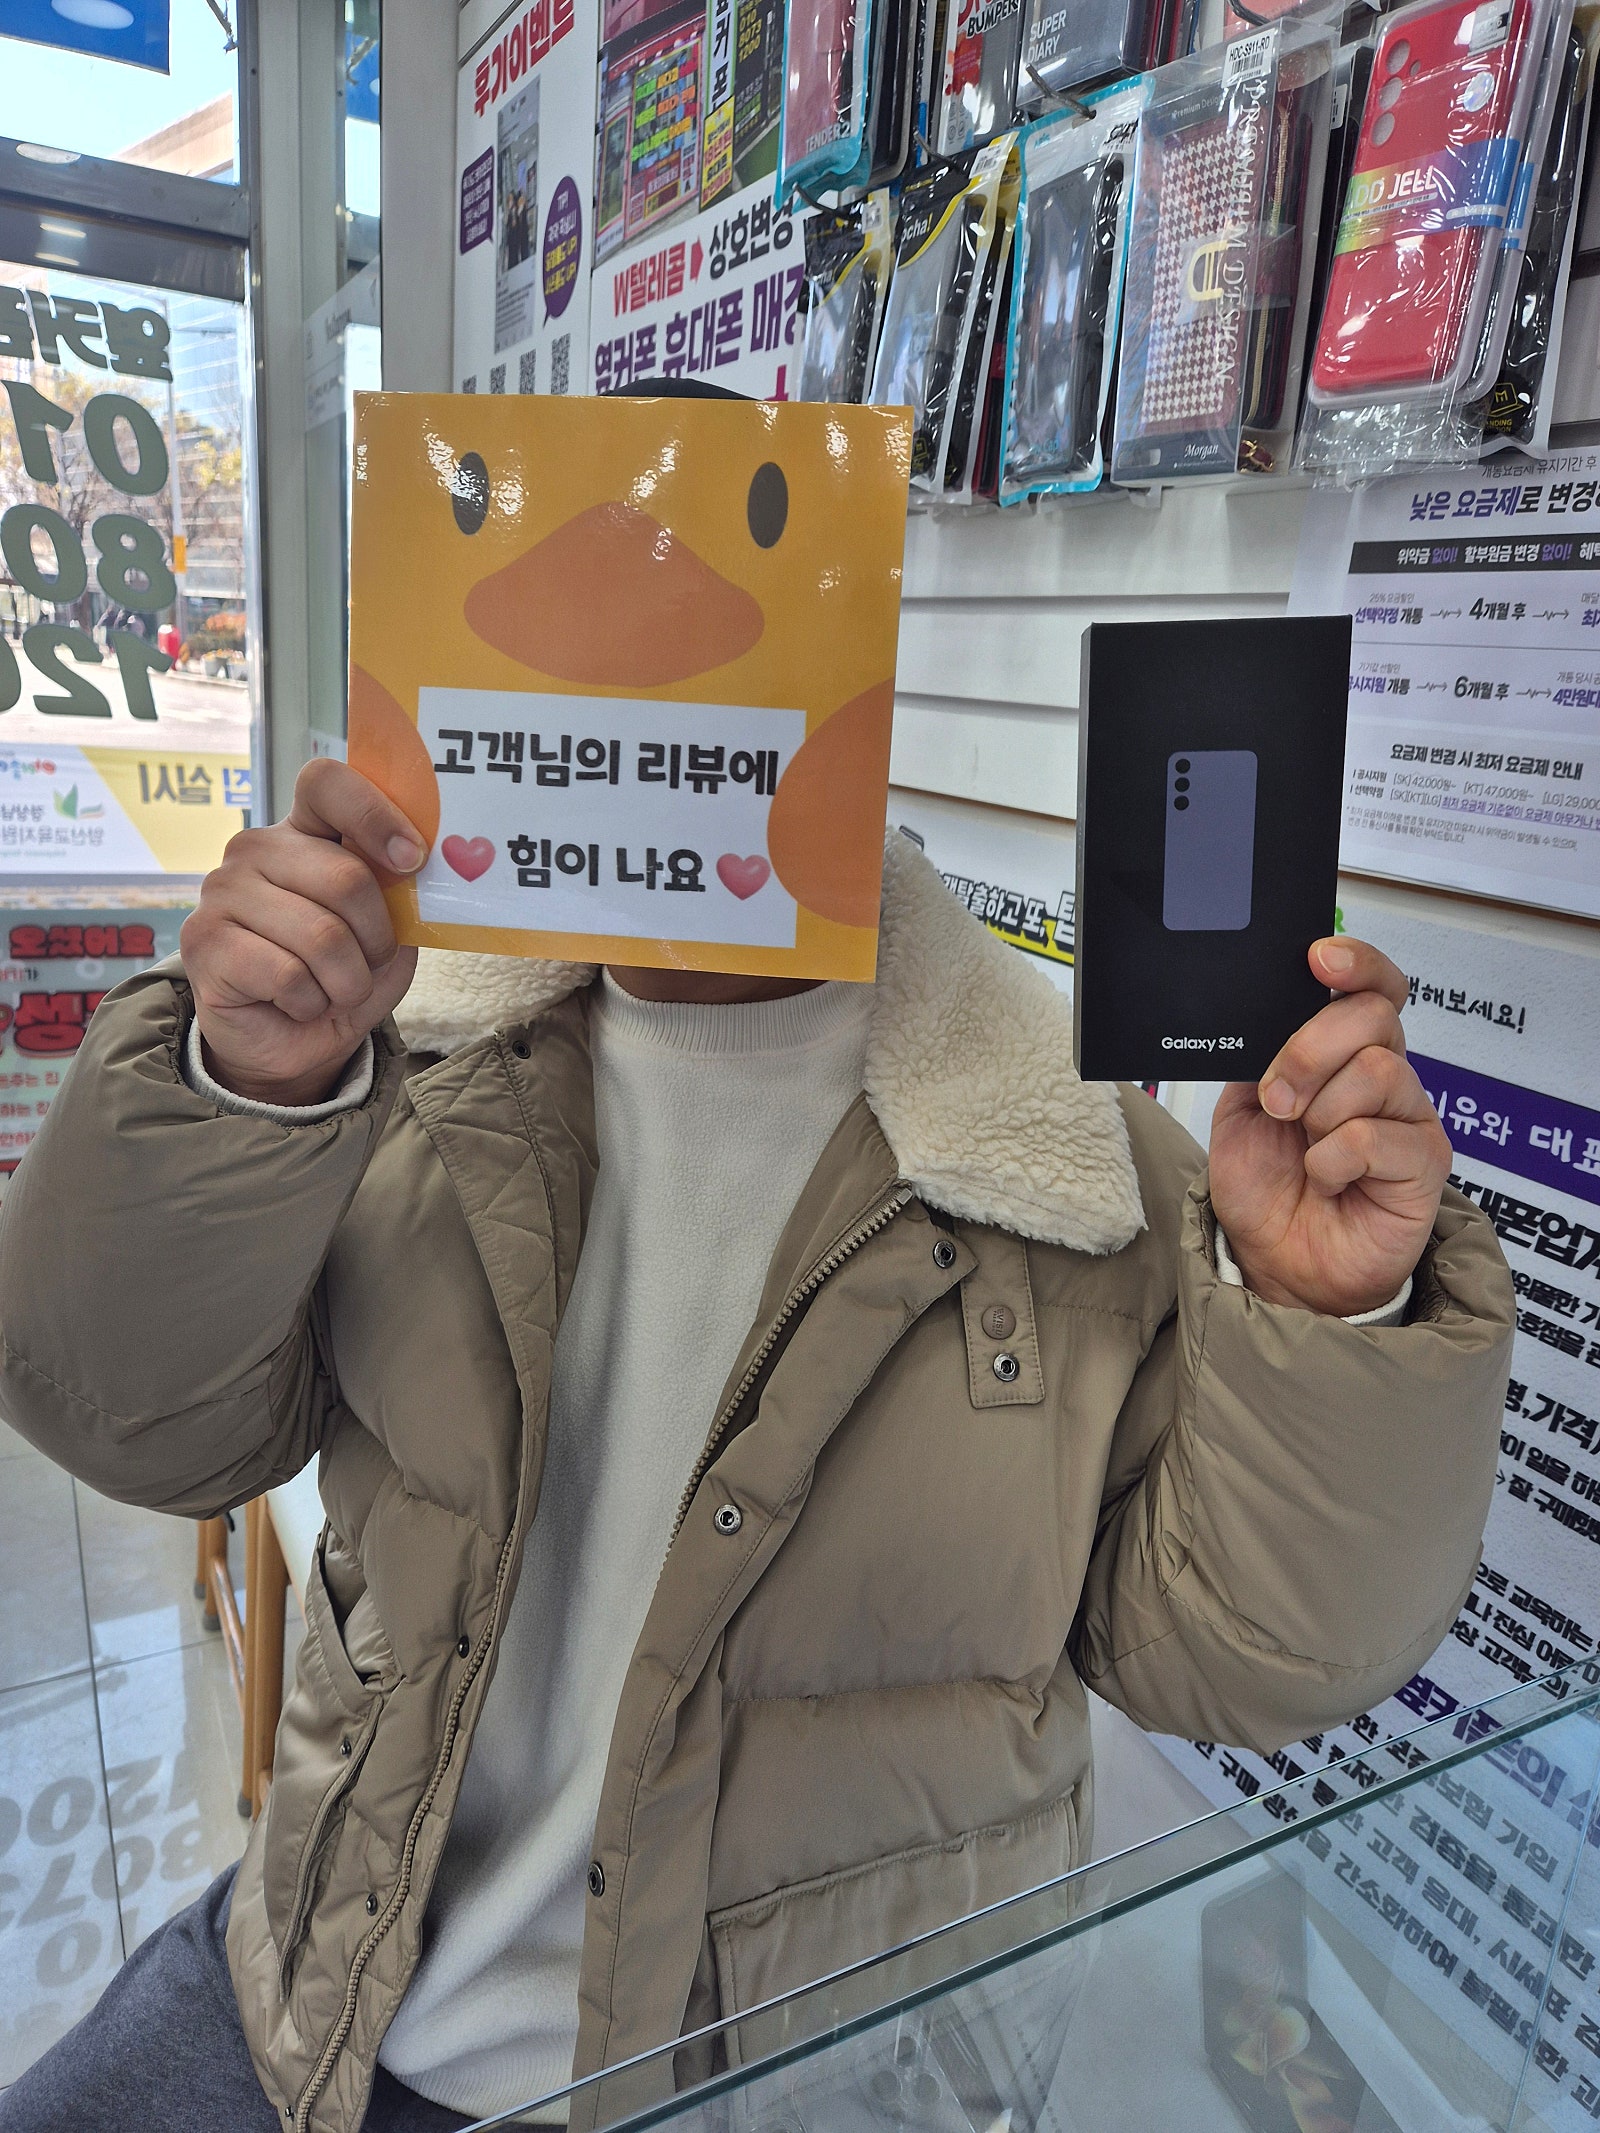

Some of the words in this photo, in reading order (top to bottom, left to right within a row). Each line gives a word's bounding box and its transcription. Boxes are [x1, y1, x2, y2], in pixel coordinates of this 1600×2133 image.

[1029, 9, 1067, 43] SUPER
[1027, 34, 1061, 64] DIARY
[1229, 35, 1271, 62] HDC-S911-RD
[1173, 102, 1201, 118] Premium
[1201, 96, 1221, 109] Desig
[1387, 165, 1438, 200] JELL
[901, 213, 933, 243] ocha!
[614, 241, 687, 318] W텔레콤
[709, 195, 794, 280] 상호변경
[663, 288, 744, 379] 휴대폰
[1184, 443, 1219, 460] Morgan
[1537, 456, 1584, 473] 유지기간
[1586, 455, 1598, 471] 후
[1409, 491, 1452, 522] 낮은
[1452, 485, 1544, 518] 요금제로
[1547, 480, 1600, 514] 변경
[1398, 548, 1431, 565] 위약금
[1431, 547, 1458, 565] 없이!
[1464, 544, 1512, 564] 할부원금
[1514, 544, 1541, 562] 변경
[1541, 543, 1573, 562] 없이!
[1355, 606, 1399, 625] 선택약정
[1400, 607, 1424, 625] 개통
[1469, 597, 1511, 621] 4개월
[1511, 602, 1527, 621] 후
[1387, 678, 1411, 696] 개통
[1454, 675, 1494, 700] 6개월
[1494, 682, 1510, 701] 후
[434, 728, 622, 787] 고객님의
[638, 741, 780, 796] 리뷰에
[1357, 769, 1388, 783] 공시지원
[1390, 743, 1429, 763] 요금제
[1430, 747, 1457, 766] 변경
[1458, 750, 1474, 769] 시
[1474, 752, 1504, 772] 최저
[1505, 755, 1550, 777] 요금제
[1552, 760, 1584, 781] 안내
[1355, 784, 1385, 799] 선택약정
[507, 834, 600, 889] 힘이
[616, 845, 706, 893] 나요
[1161, 1036, 1217, 1053] Galaxy
[1218, 1036, 1245, 1050] S24
[1516, 1308, 1586, 1359] 호점을
[1449, 1616, 1480, 1648] 상
[1508, 1584, 1594, 1653] 교육하는
[1366, 1827, 1422, 1886] 고객
[1496, 1818, 1560, 1884] 가입
[1333, 1851, 1460, 1978] 간소화하여
